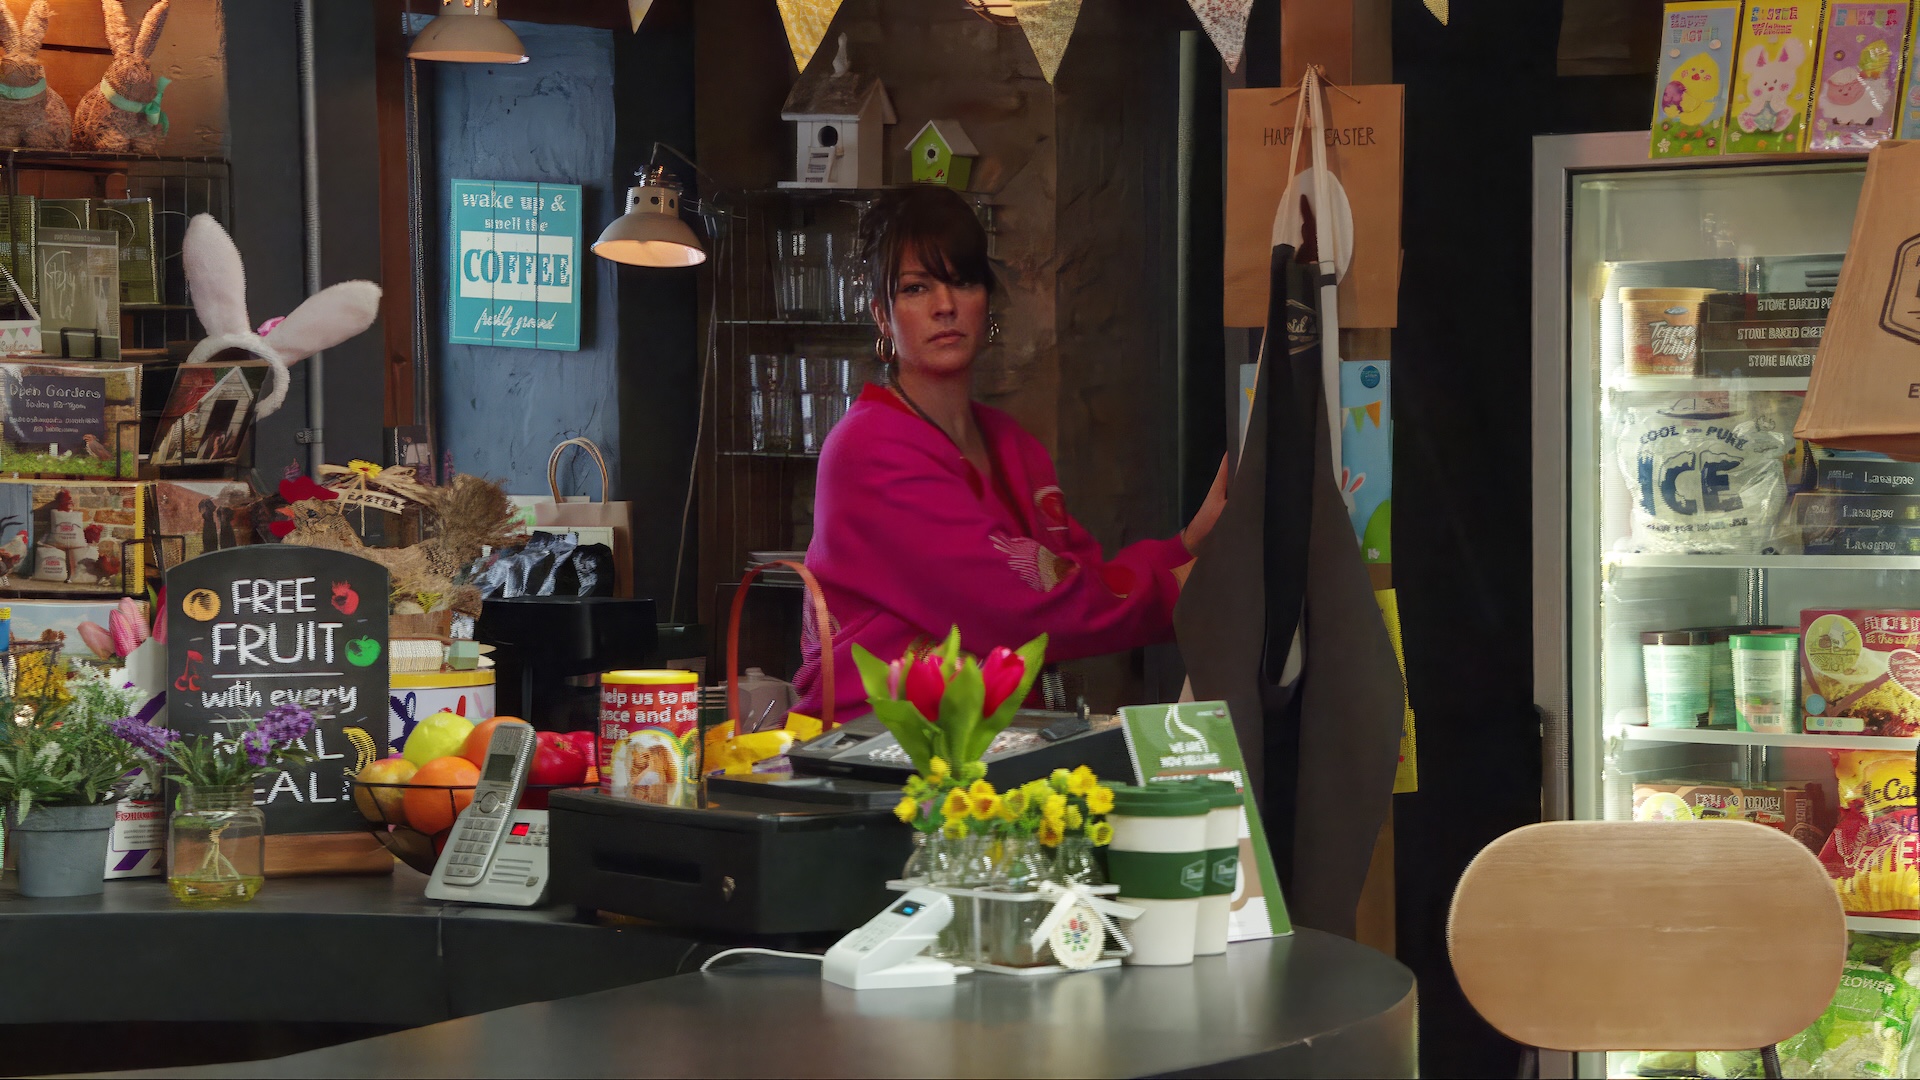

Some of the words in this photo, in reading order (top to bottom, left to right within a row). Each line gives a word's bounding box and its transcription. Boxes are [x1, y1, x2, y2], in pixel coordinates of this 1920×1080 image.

[1264, 127, 1296, 146] HAP
[1324, 127, 1377, 146] EASTER
[462, 190, 514, 209] wake
[520, 196, 545, 217] up
[551, 194, 566, 212] &
[484, 216, 521, 231] smell
[525, 217, 548, 232] the
[463, 248, 570, 287] COFFEE
[1640, 425, 1680, 445] COOL
[1706, 426, 1748, 450] PURE
[1637, 450, 1744, 516] ICE
[1864, 471, 1915, 488] Lasagne
[1843, 505, 1895, 521] Lasagne
[1844, 538, 1897, 553] Lasagne
[231, 577, 316, 615] FREE
[211, 620, 344, 666] FRUIT
[201, 680, 263, 709] with
[269, 685, 358, 713] every
[631, 692, 653, 705] us
[658, 690, 679, 705] to
[635, 706, 672, 723] and
